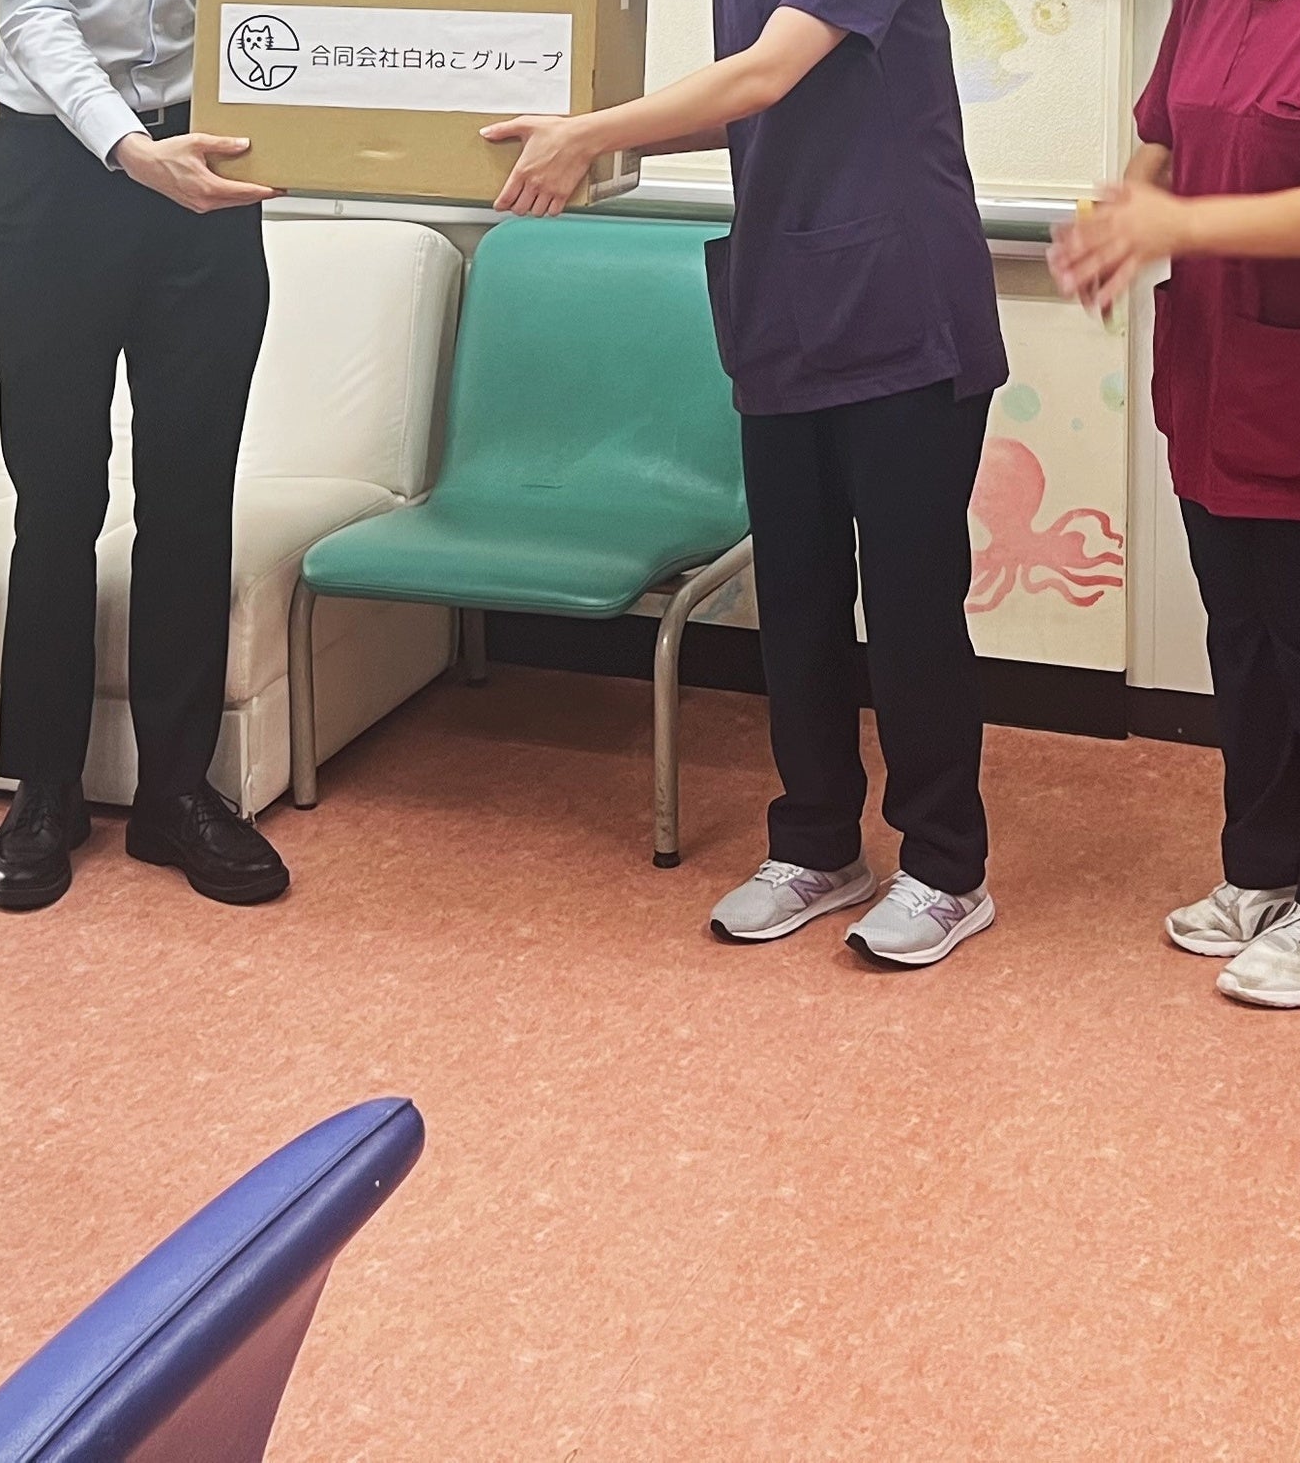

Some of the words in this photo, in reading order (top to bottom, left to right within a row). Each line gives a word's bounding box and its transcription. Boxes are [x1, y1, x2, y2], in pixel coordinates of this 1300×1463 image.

[311, 44, 563, 72] 合同会社白ねこグループ
